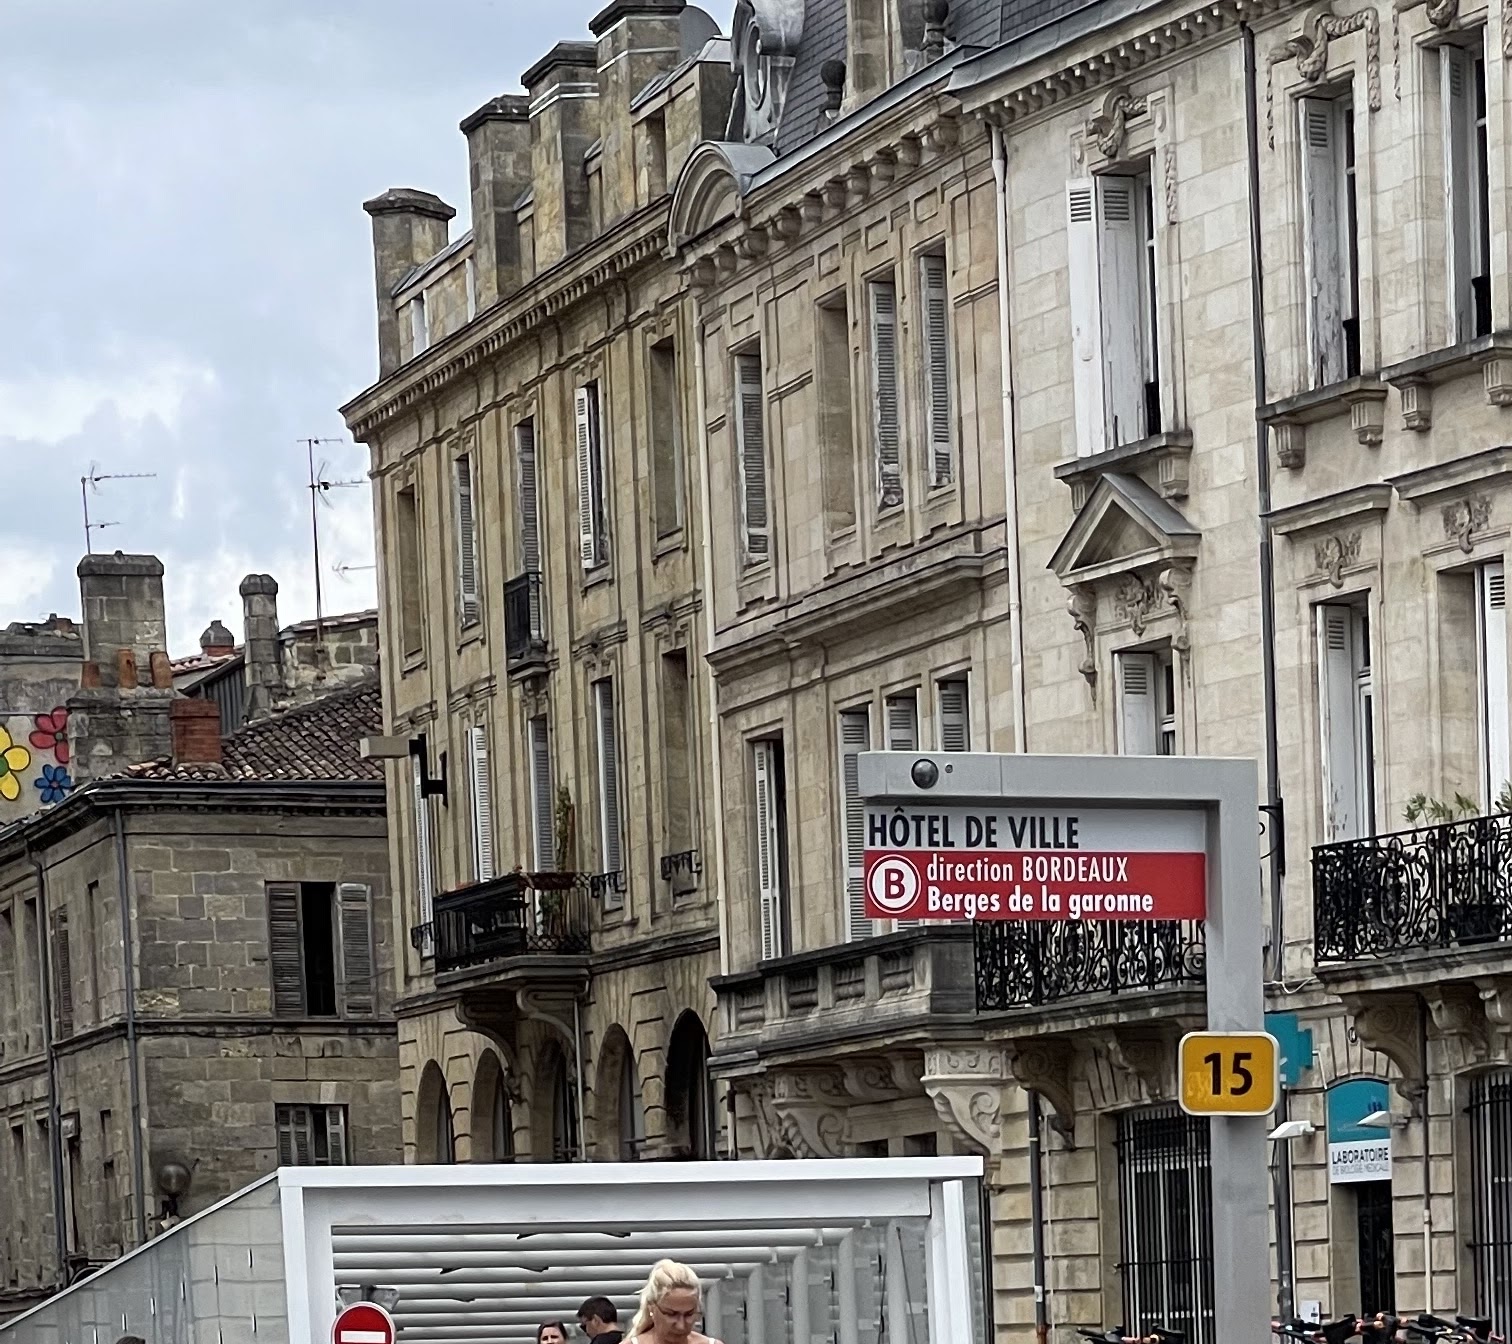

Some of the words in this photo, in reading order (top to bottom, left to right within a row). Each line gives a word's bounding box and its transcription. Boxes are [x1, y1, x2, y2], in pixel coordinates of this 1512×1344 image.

[868, 807, 954, 848] HÔTEL
[966, 817, 997, 848] DE
[1009, 816, 1079, 849] VILLE
[884, 868, 905, 899] B
[927, 853, 1013, 882] direction
[1022, 857, 1128, 882] BORDEAUX
[927, 887, 1000, 919] Berges
[1008, 885, 1034, 912] de
[1041, 885, 1061, 912] la
[1068, 892, 1153, 919] garonne
[1204, 1052, 1253, 1096] 15
[1332, 1147, 1388, 1165] LABORATOIRE
